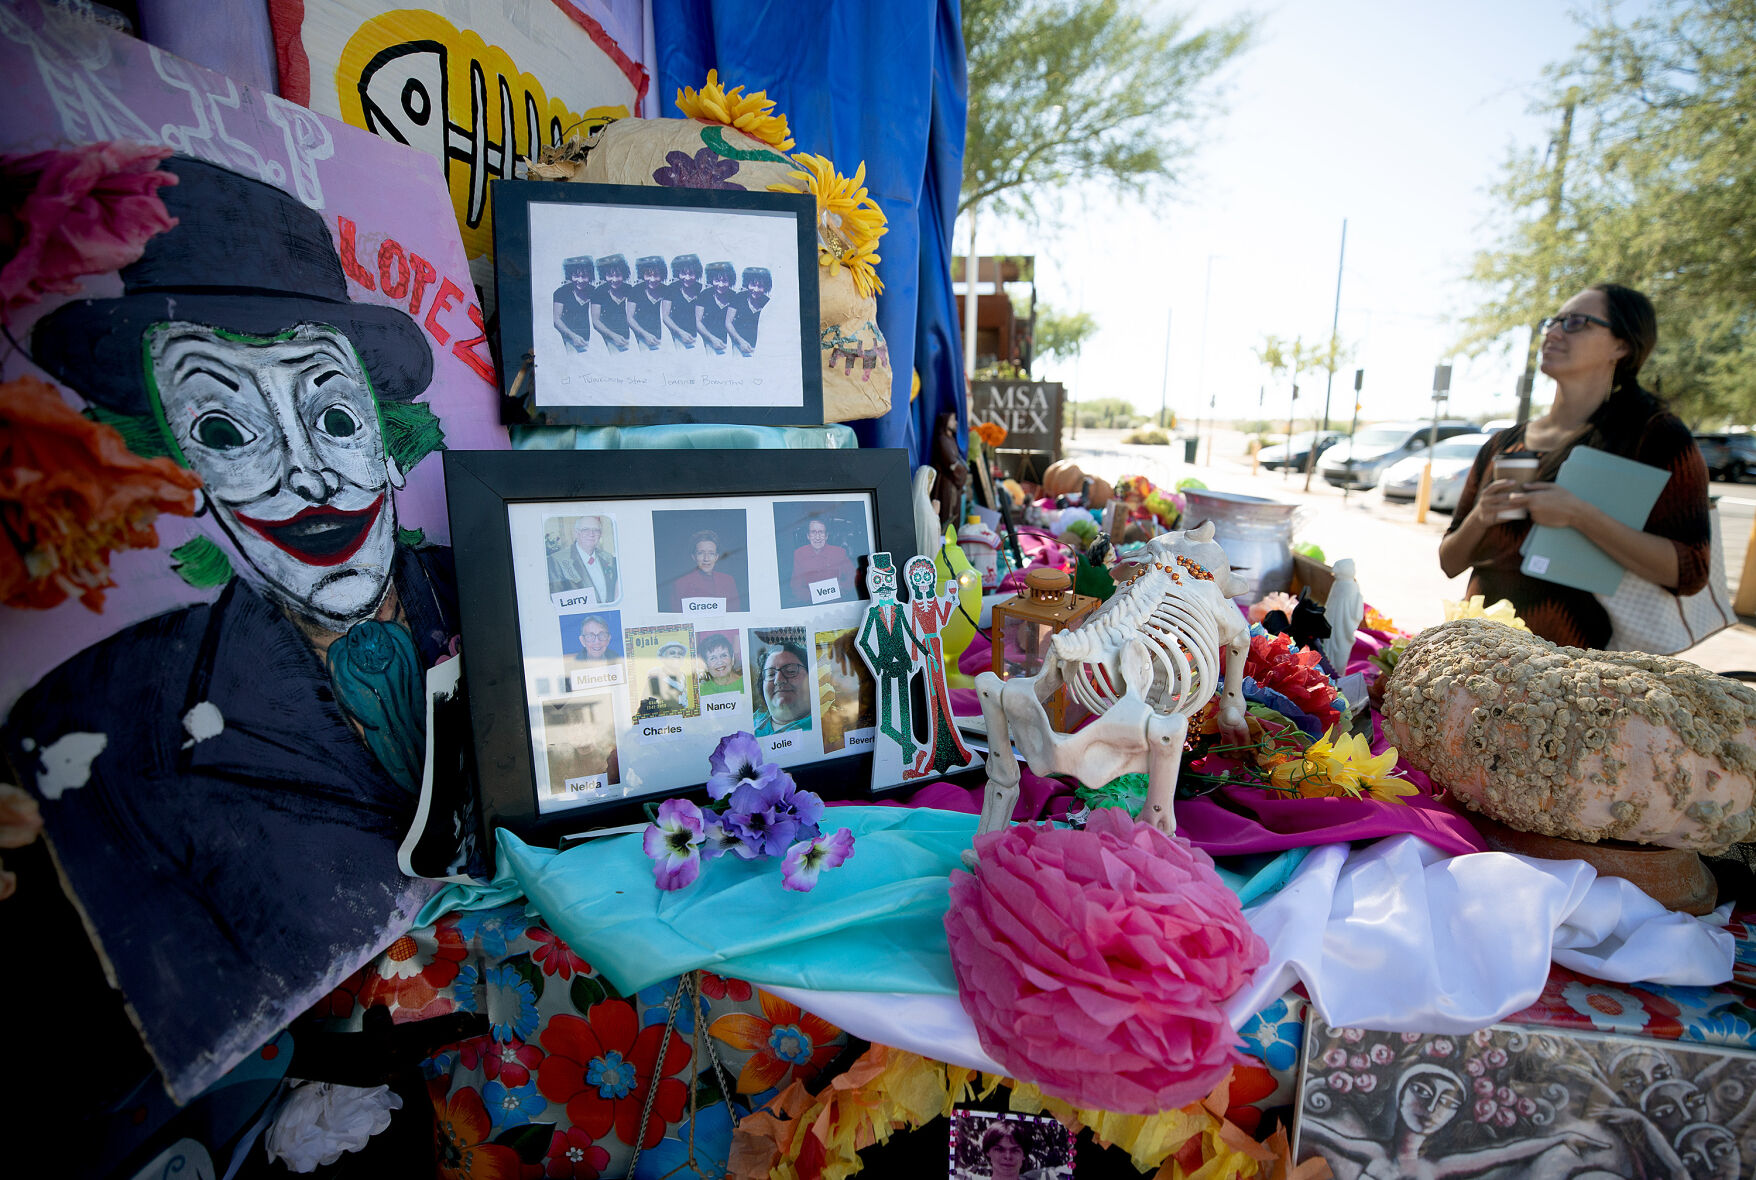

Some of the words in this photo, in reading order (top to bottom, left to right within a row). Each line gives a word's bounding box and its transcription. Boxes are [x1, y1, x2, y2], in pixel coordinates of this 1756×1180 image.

[338, 215, 498, 388] LOPEZ
[989, 386, 1049, 409] MSA
[971, 409, 1048, 434] NNEX
[817, 586, 836, 597] Vera
[559, 594, 588, 608] Larry
[688, 601, 719, 611] Grace
[576, 673, 618, 686] Minette
[706, 701, 737, 712] Nancy
[643, 725, 682, 737] Charles
[771, 739, 793, 751] Jolie
[849, 735, 875, 746] Beverl
[570, 780, 602, 793] Nelda
